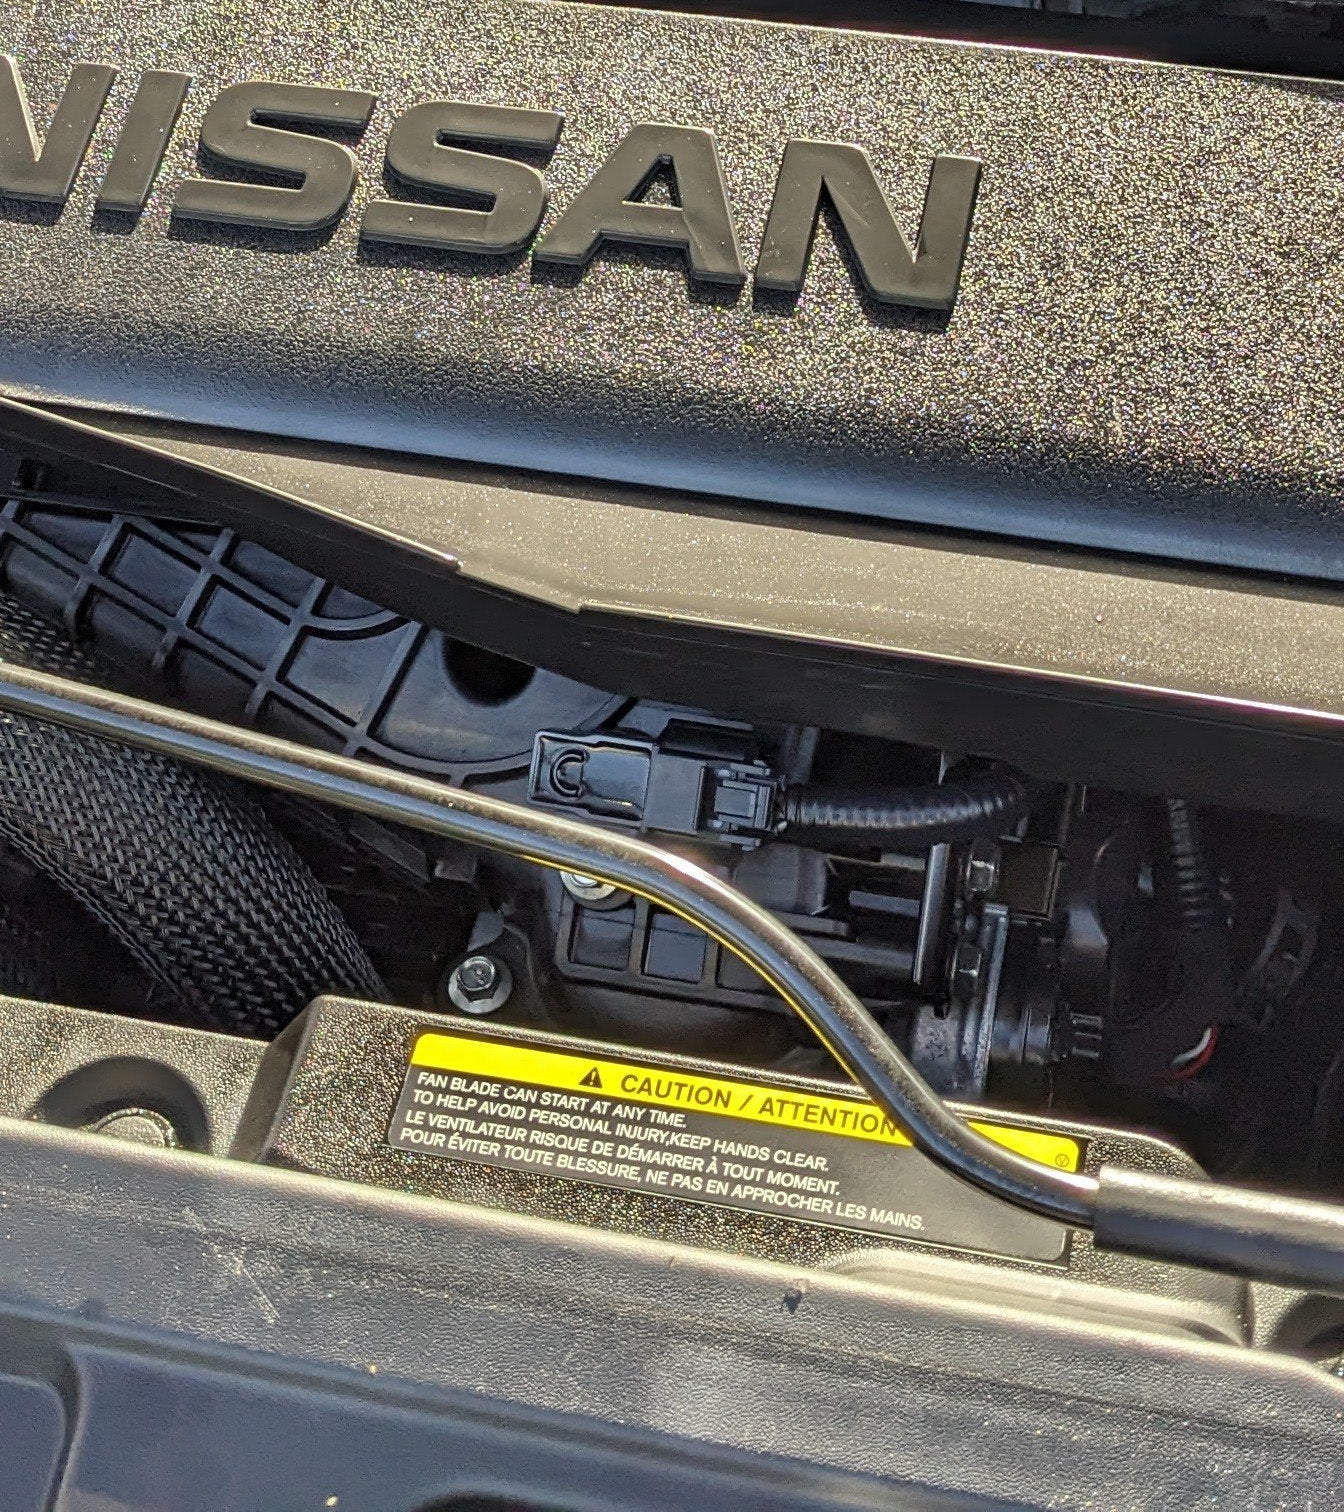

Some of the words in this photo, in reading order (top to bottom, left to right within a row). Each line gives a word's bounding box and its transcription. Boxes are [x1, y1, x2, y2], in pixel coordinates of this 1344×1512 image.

[413, 1089, 434, 1105] TO
[435, 1093, 478, 1111] HELP
[478, 1101, 527, 1120] AVOID
[528, 1108, 612, 1135] PERSONAL
[713, 1139, 770, 1162] HANDS
[773, 1149, 830, 1172] CLEAR.
[417, 1071, 449, 1089] FAN
[450, 1077, 502, 1097] BLADE
[503, 1085, 538, 1103] CAN
[539, 1092, 590, 1112] START
[590, 1099, 612, 1115] AT
[611, 1103, 647, 1121] ANY
[648, 1109, 687, 1128] TIME.
[620, 1074, 732, 1109] CAUTION
[738, 1094, 754, 1111] /
[758, 1096, 897, 1137] ATTENTION
[399, 1127, 446, 1148] POUR
[447, 1132, 501, 1157] ÉVITER
[501, 1144, 555, 1166] TOUTE
[556, 1153, 642, 1183] BLESSURE,
[645, 1168, 670, 1185] NE
[670, 1173, 704, 1191] PAS
[705, 1179, 730, 1196] EN
[730, 1183, 834, 1214] APPROCHER
[835, 1201, 868, 1220] LES
[870, 1208, 925, 1231] MAINS.
[406, 1109, 426, 1125] LE
[428, 1113, 528, 1142] VENTILATEUR
[529, 1129, 591, 1153] RISQUE
[591, 1140, 617, 1157] DE
[616, 1142, 705, 1172] DÉMARRER
[705, 1156, 718, 1174] À
[722, 1161, 765, 1182] TOUT
[766, 1170, 841, 1196] MOMENT.
